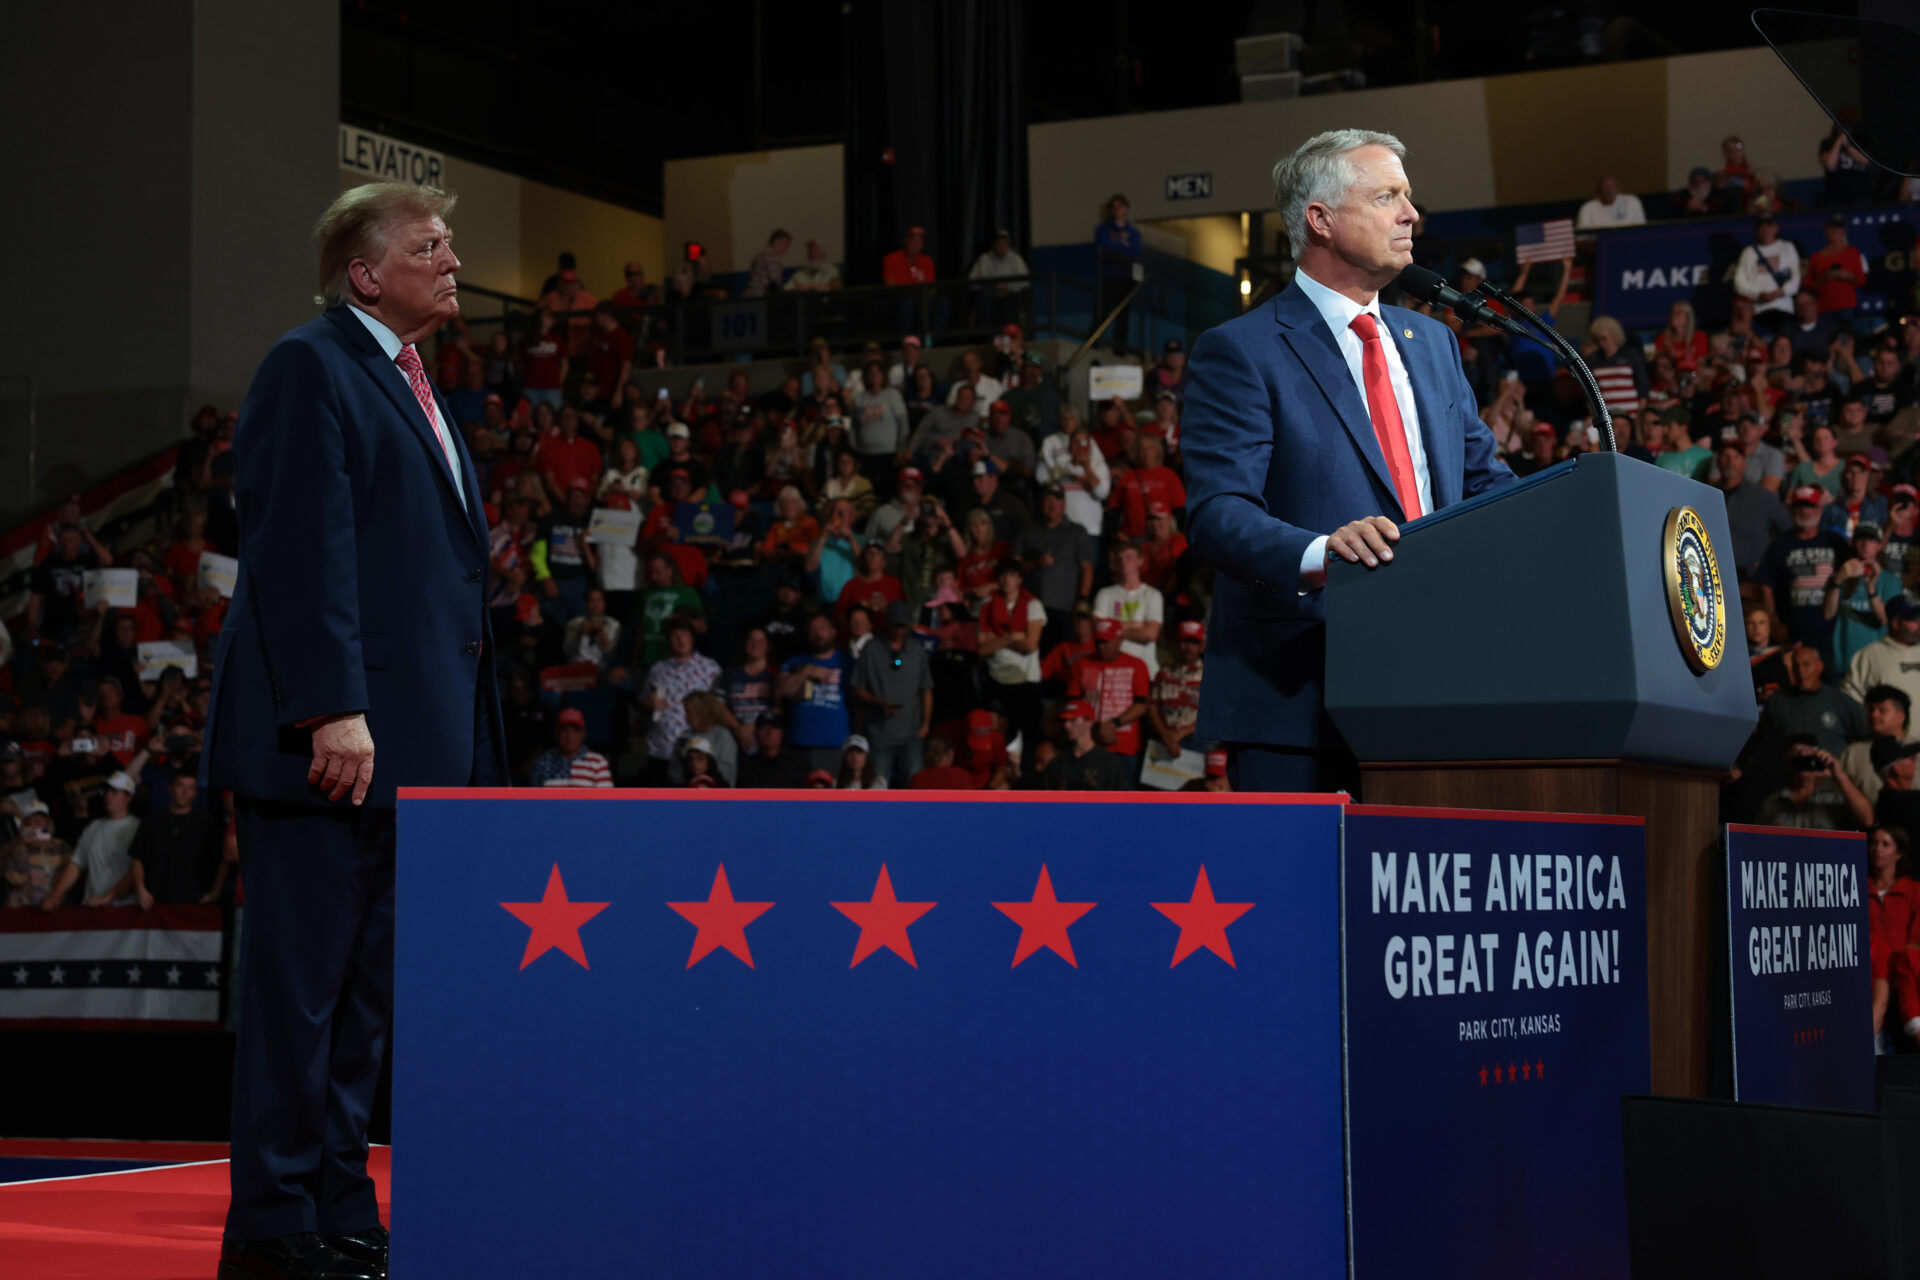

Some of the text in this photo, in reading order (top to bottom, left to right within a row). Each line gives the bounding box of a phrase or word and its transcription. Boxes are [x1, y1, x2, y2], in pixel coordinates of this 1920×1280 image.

[341, 129, 442, 188] LEVATOR
[1168, 176, 1209, 198] MEN
[1621, 264, 1710, 291] MAKE
[721, 313, 757, 338] 101
[1371, 851, 1627, 914] MAKE AMERICA
[1741, 860, 1860, 909] MAKE AMERICA
[1384, 929, 1620, 1000] GREAT AGAIN!
[1749, 923, 1859, 976] GREAT AGAIN!
[1784, 989, 1832, 1010] PARK CITY, KANSAS
[1459, 1013, 1562, 1042] PARK CITY, KANSAS
